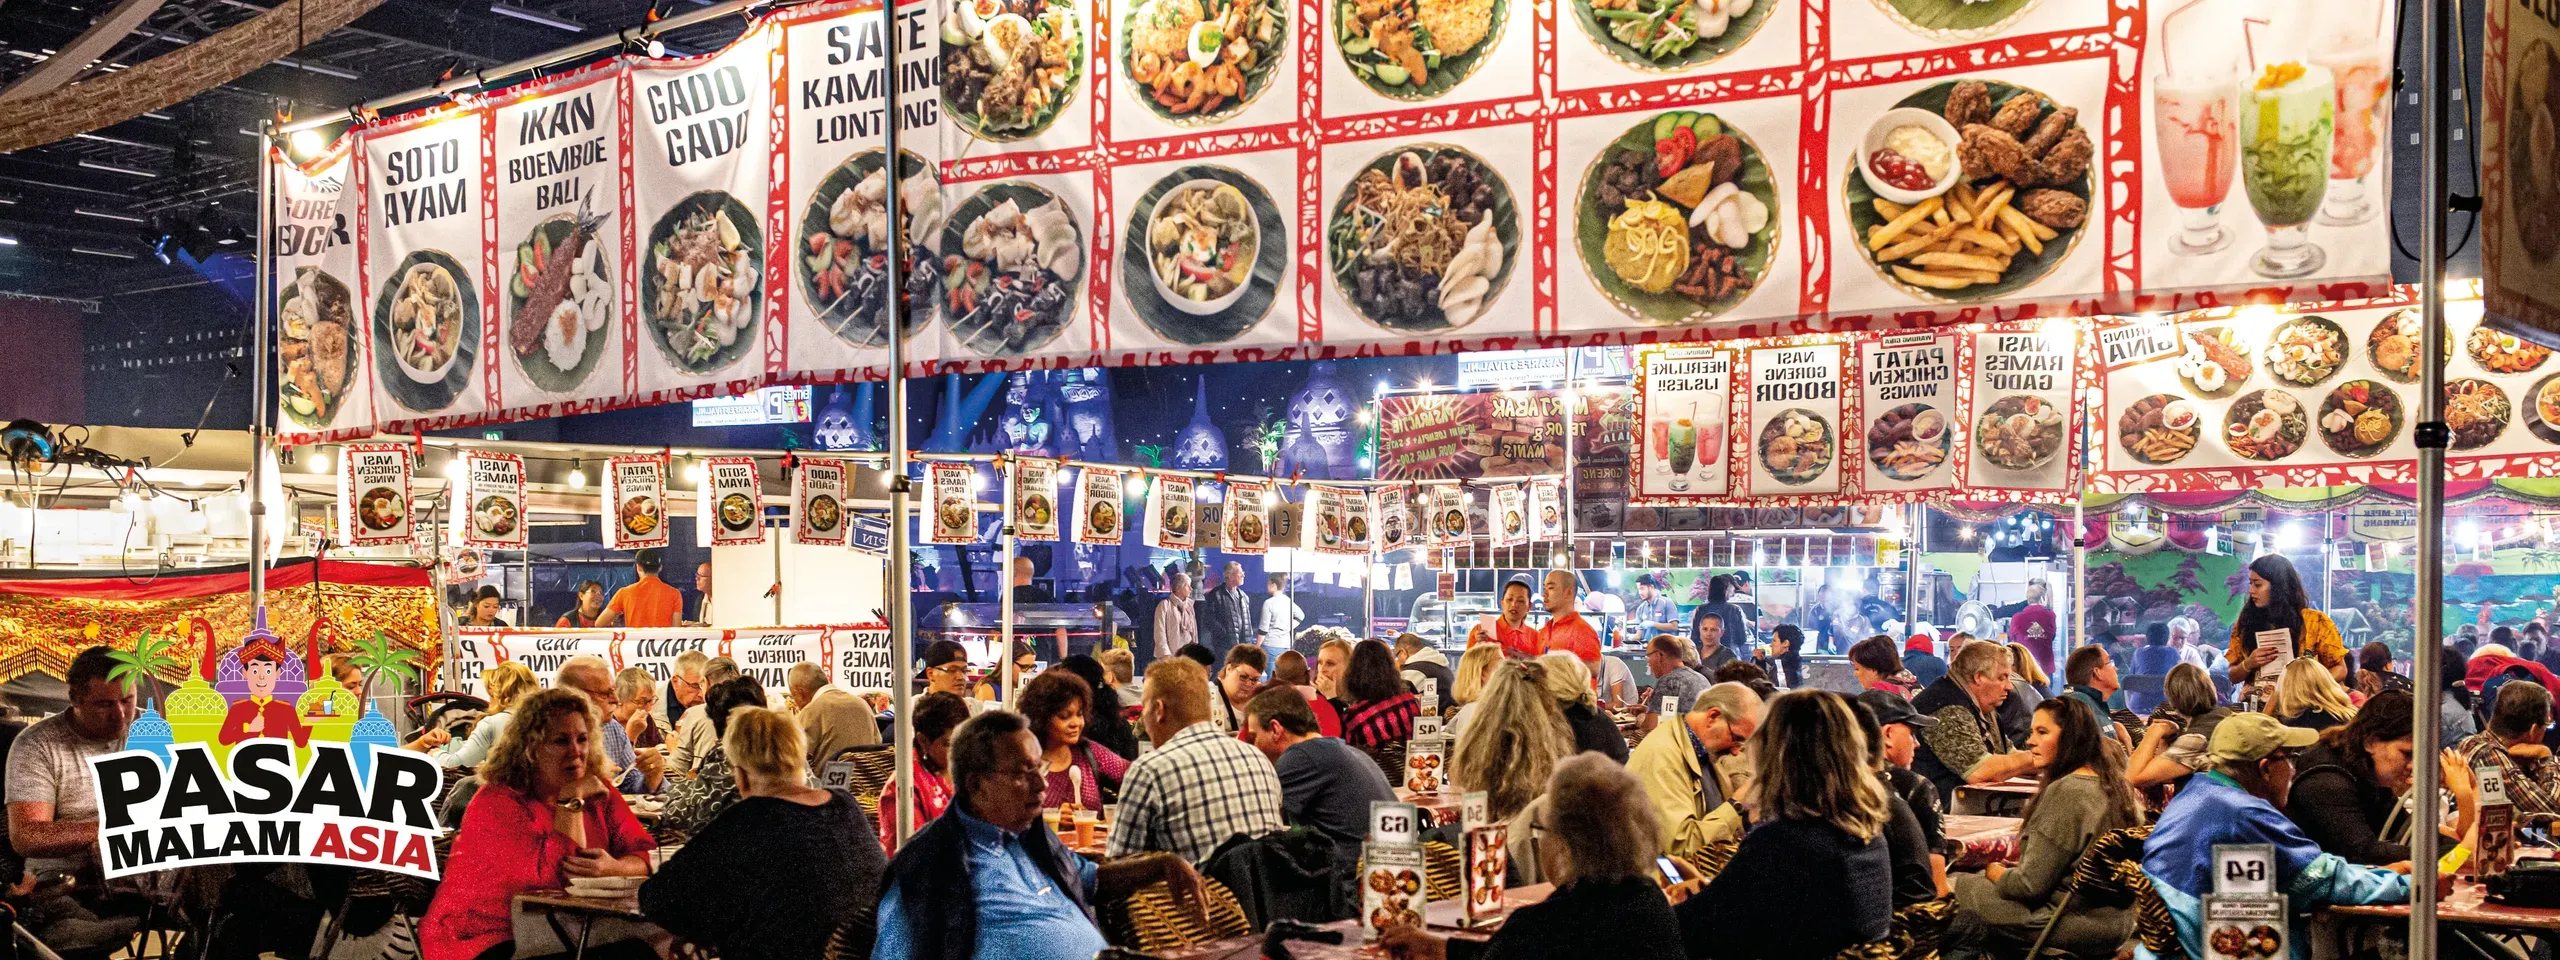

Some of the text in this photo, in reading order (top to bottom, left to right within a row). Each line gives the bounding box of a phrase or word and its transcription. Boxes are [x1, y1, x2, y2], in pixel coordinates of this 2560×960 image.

[647, 66, 746, 125] GADO
[802, 56, 941, 110] KAMIN
[519, 92, 595, 146] IKAN
[665, 108, 750, 167] GADO
[816, 98, 937, 144] LONTNG
[386, 138, 459, 186] SOTO
[508, 136, 608, 185] BOEMBOE
[285, 196, 339, 221] GORE
[384, 178, 467, 228] AYAM
[536, 176, 580, 211] BALI
[278, 213, 352, 257] BOGR
